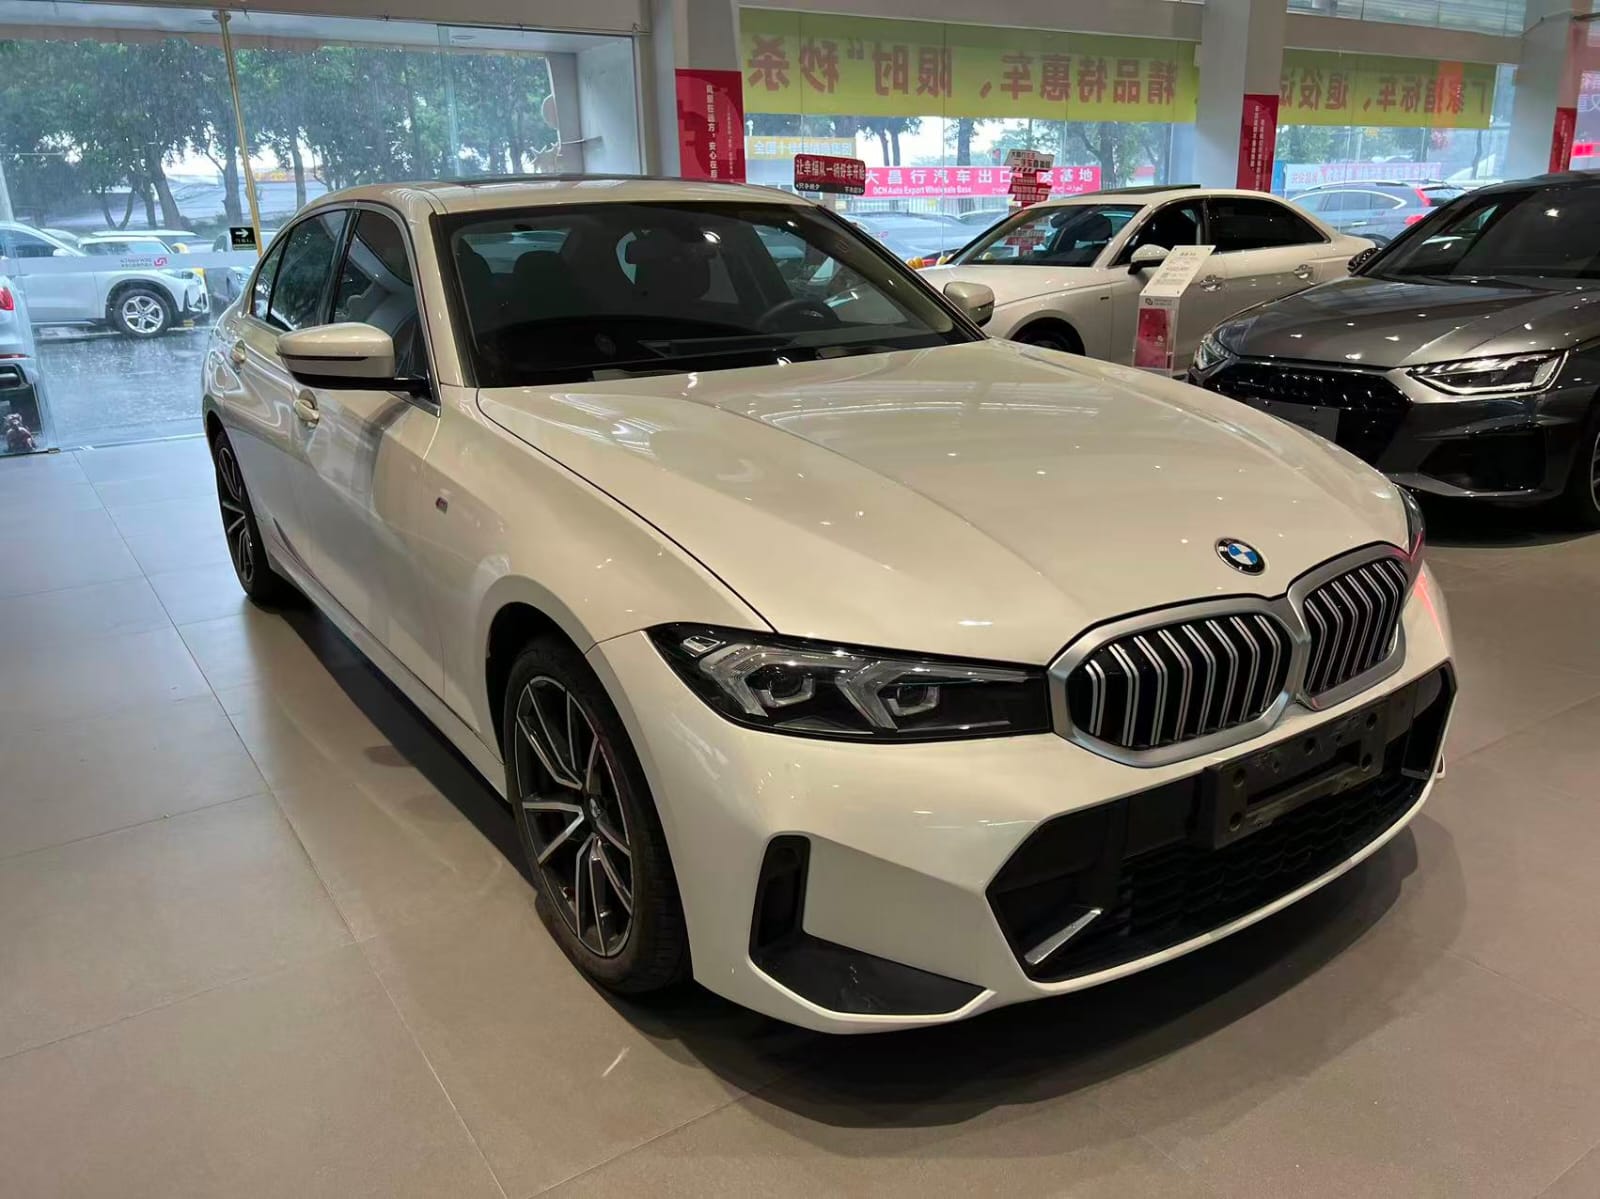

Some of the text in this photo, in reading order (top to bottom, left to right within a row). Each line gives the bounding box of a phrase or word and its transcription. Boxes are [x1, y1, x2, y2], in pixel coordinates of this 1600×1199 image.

[865, 168, 1094, 185] 大昌行汽车出口发基地
